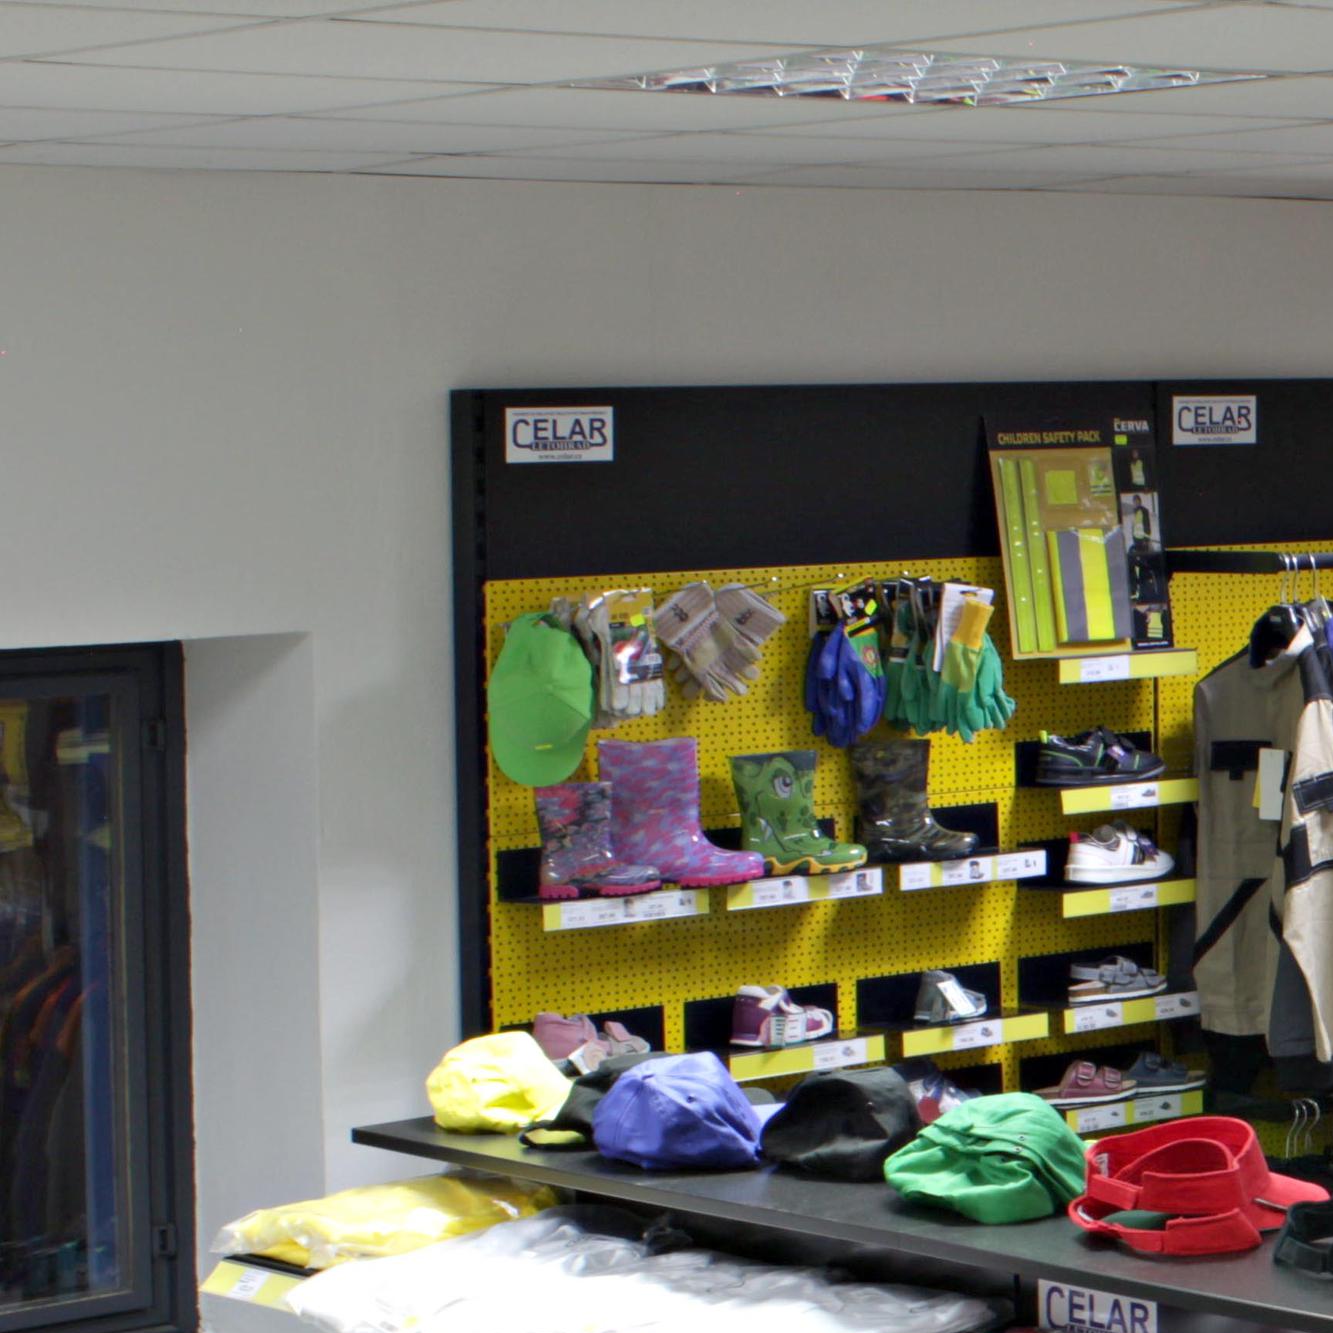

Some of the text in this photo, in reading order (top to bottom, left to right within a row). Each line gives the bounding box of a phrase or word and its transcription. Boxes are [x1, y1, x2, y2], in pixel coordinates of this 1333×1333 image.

[1178, 405, 1251, 432] CELAR
[512, 418, 607, 448] CELAR
[997, 430, 1100, 445] CHILDREN SAFETY PACK
